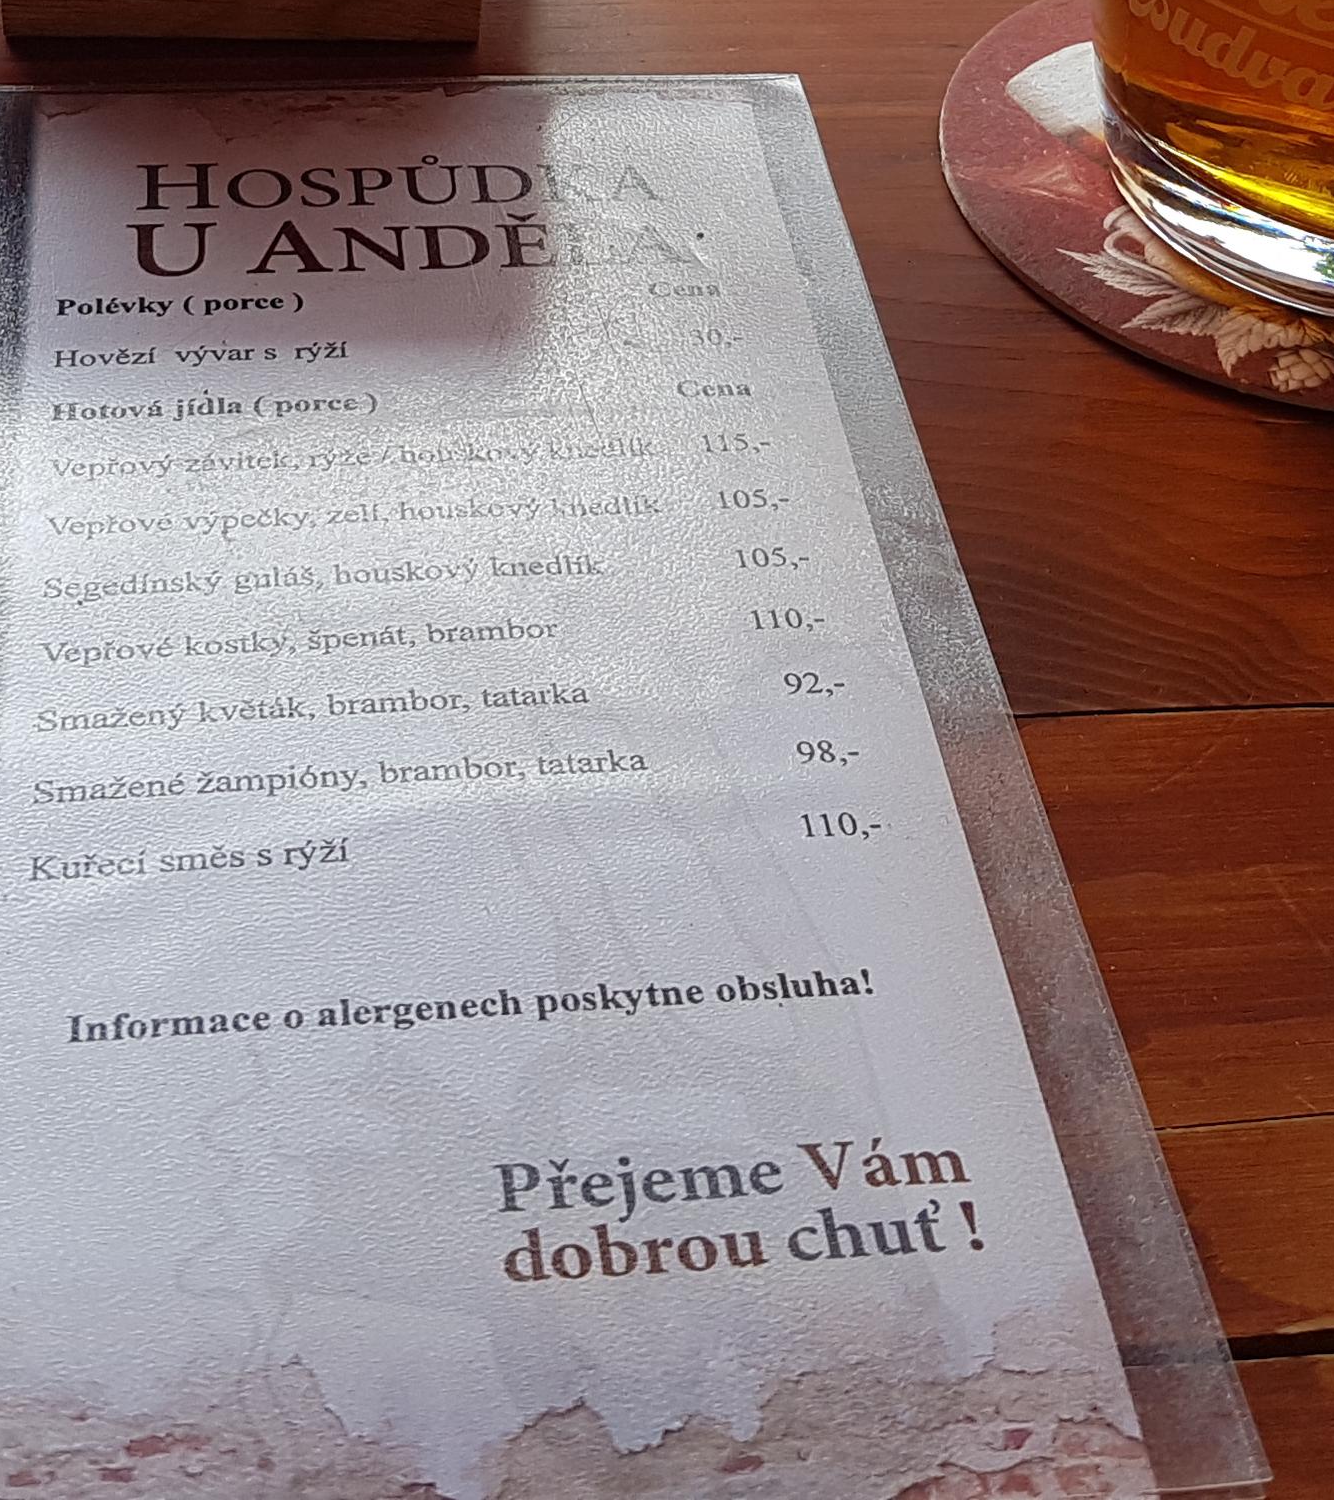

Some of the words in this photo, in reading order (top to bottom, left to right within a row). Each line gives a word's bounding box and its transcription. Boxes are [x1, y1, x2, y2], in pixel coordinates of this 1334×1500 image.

[125, 221, 218, 278] U
[648, 280, 721, 298] Cena
[55, 295, 175, 318] Polévky
[202, 294, 285, 317] porce
[53, 345, 158, 368] Hovězí
[174, 344, 256, 367] vývar
[263, 347, 278, 361] s
[294, 339, 350, 364] rýží
[675, 378, 753, 399] Cena
[50, 398, 165, 422] Hotová
[172, 394, 244, 422] jídla
[273, 395, 360, 418] porce
[701, 432, 772, 454] 115,-
[51, 454, 174, 481] Vepřový
[183, 449, 301, 473] závitek,
[308, 446, 374, 472] rýže
[716, 488, 791, 513] 105,-
[46, 513, 174, 540] Vepřové
[326, 502, 389, 526] zelí,
[398, 497, 541, 521] houskový
[735, 545, 811, 571] 105,-
[41, 570, 223, 602] Segedínský
[234, 563, 325, 595] guláš,
[332, 555, 479, 586] houskový
[490, 553, 604, 579] knedlík
[749, 606, 827, 633] 110,-
[41, 637, 174, 668] Vepřové
[183, 630, 298, 658] kostky,
[307, 624, 418, 656] špenát,
[426, 617, 560, 647] brambor
[783, 671, 846, 698] 92,-
[35, 701, 189, 733] Smažený
[198, 696, 317, 724] květák,
[325, 687, 471, 718] brambor,
[480, 681, 591, 710] tatarka
[795, 738, 861, 768] 98,-
[32, 771, 186, 804] Smažené
[196, 764, 368, 797] žampióny,
[378, 755, 527, 786] brambor,
[537, 749, 650, 777] tatarka
[799, 810, 883, 842] 110,-
[28, 848, 148, 883] Kuřecí
[158, 844, 246, 874] směs
[256, 848, 273, 867] s
[283, 836, 350, 871] rýží
[65, 1011, 272, 1044] Informace
[283, 1007, 304, 1030] o
[317, 987, 524, 1032] alergenech
[535, 981, 705, 1021] poskytne
[715, 967, 875, 1003] obsluha!
[493, 1155, 784, 1223] Přejeme
[796, 1136, 972, 1191] Vám
[502, 1223, 770, 1284] dobrou
[786, 1198, 948, 1263] chuť
